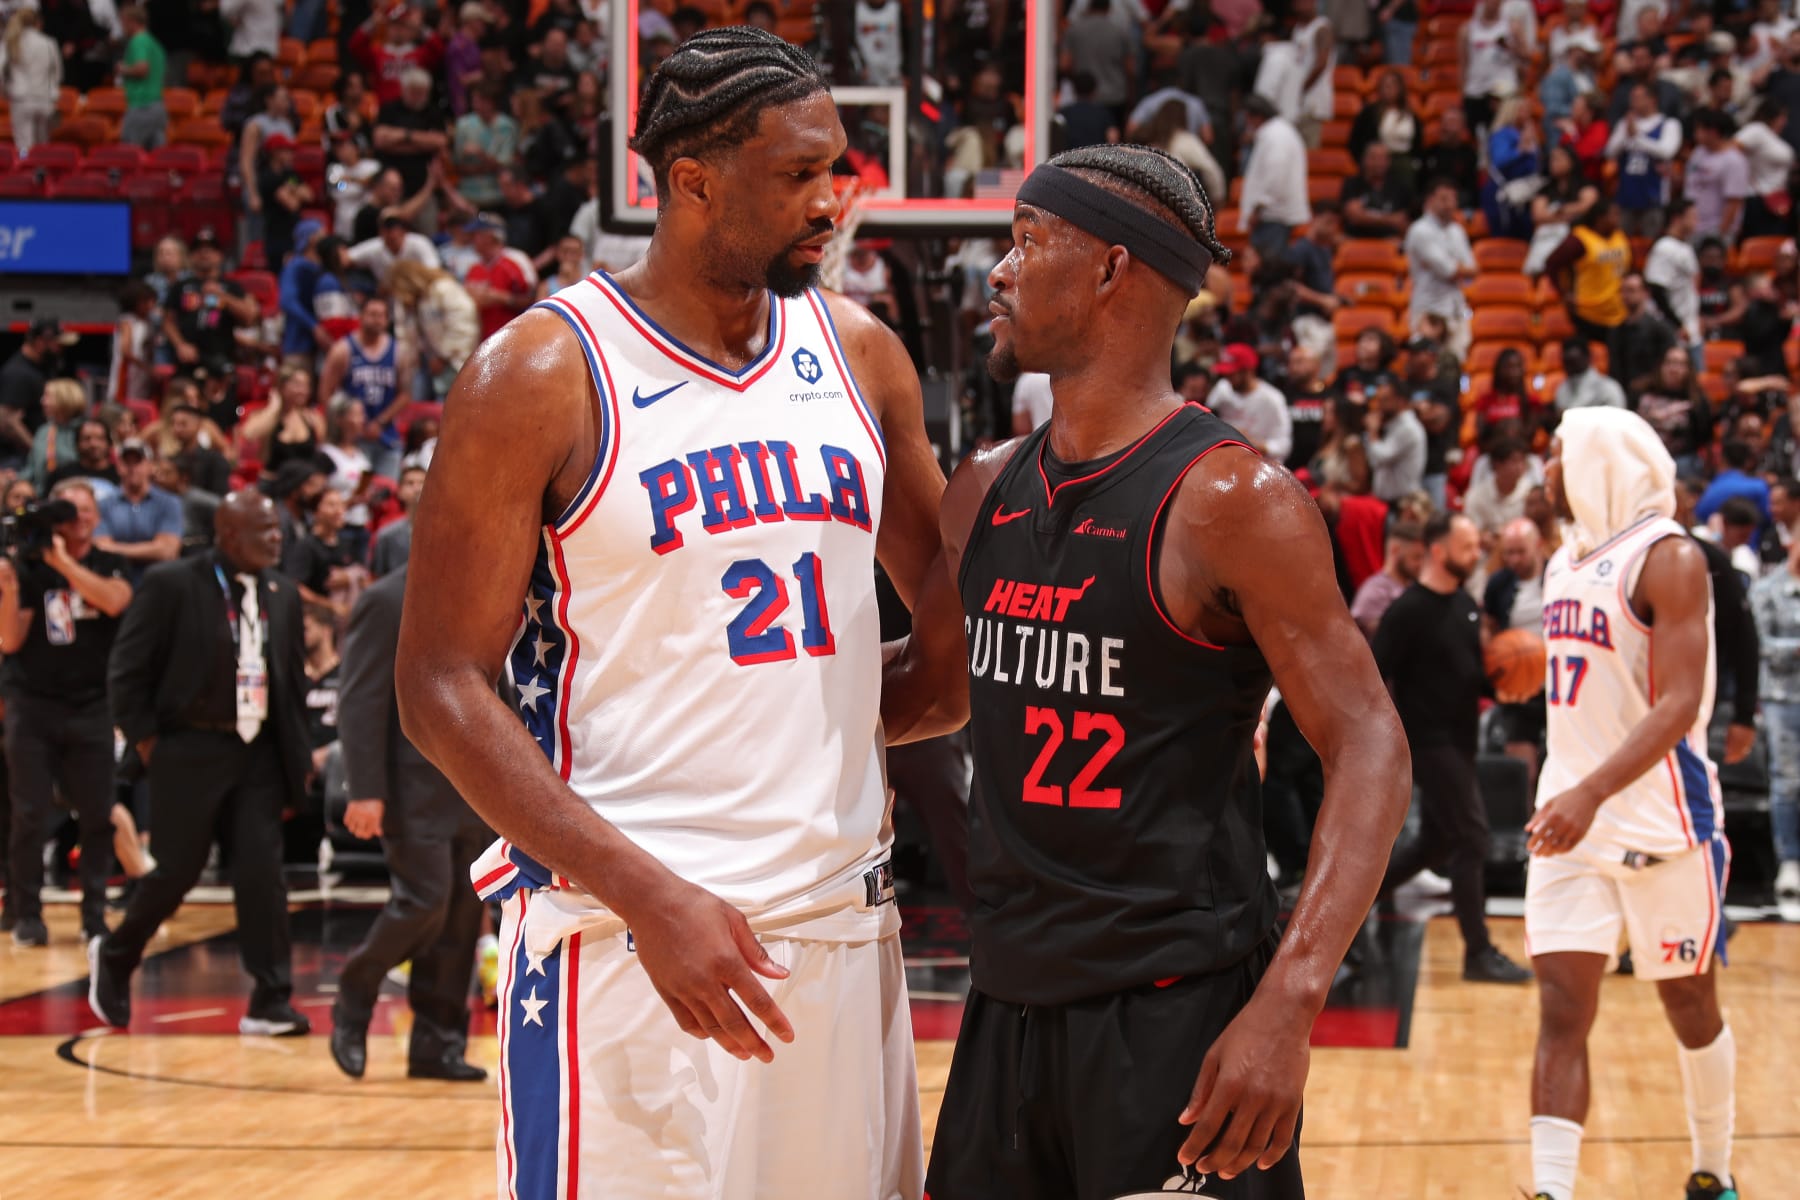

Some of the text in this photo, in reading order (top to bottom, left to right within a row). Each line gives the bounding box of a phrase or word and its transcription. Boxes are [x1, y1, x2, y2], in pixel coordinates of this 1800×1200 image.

[789, 391, 843, 403] crypto.com
[638, 440, 872, 556] PHILA
[1086, 525, 1127, 539] Carnival
[720, 551, 836, 667] 21
[984, 575, 1096, 622] HEAT
[1549, 656, 1588, 706] 17
[1022, 705, 1126, 809] 22
[1661, 939, 1696, 963] 76
